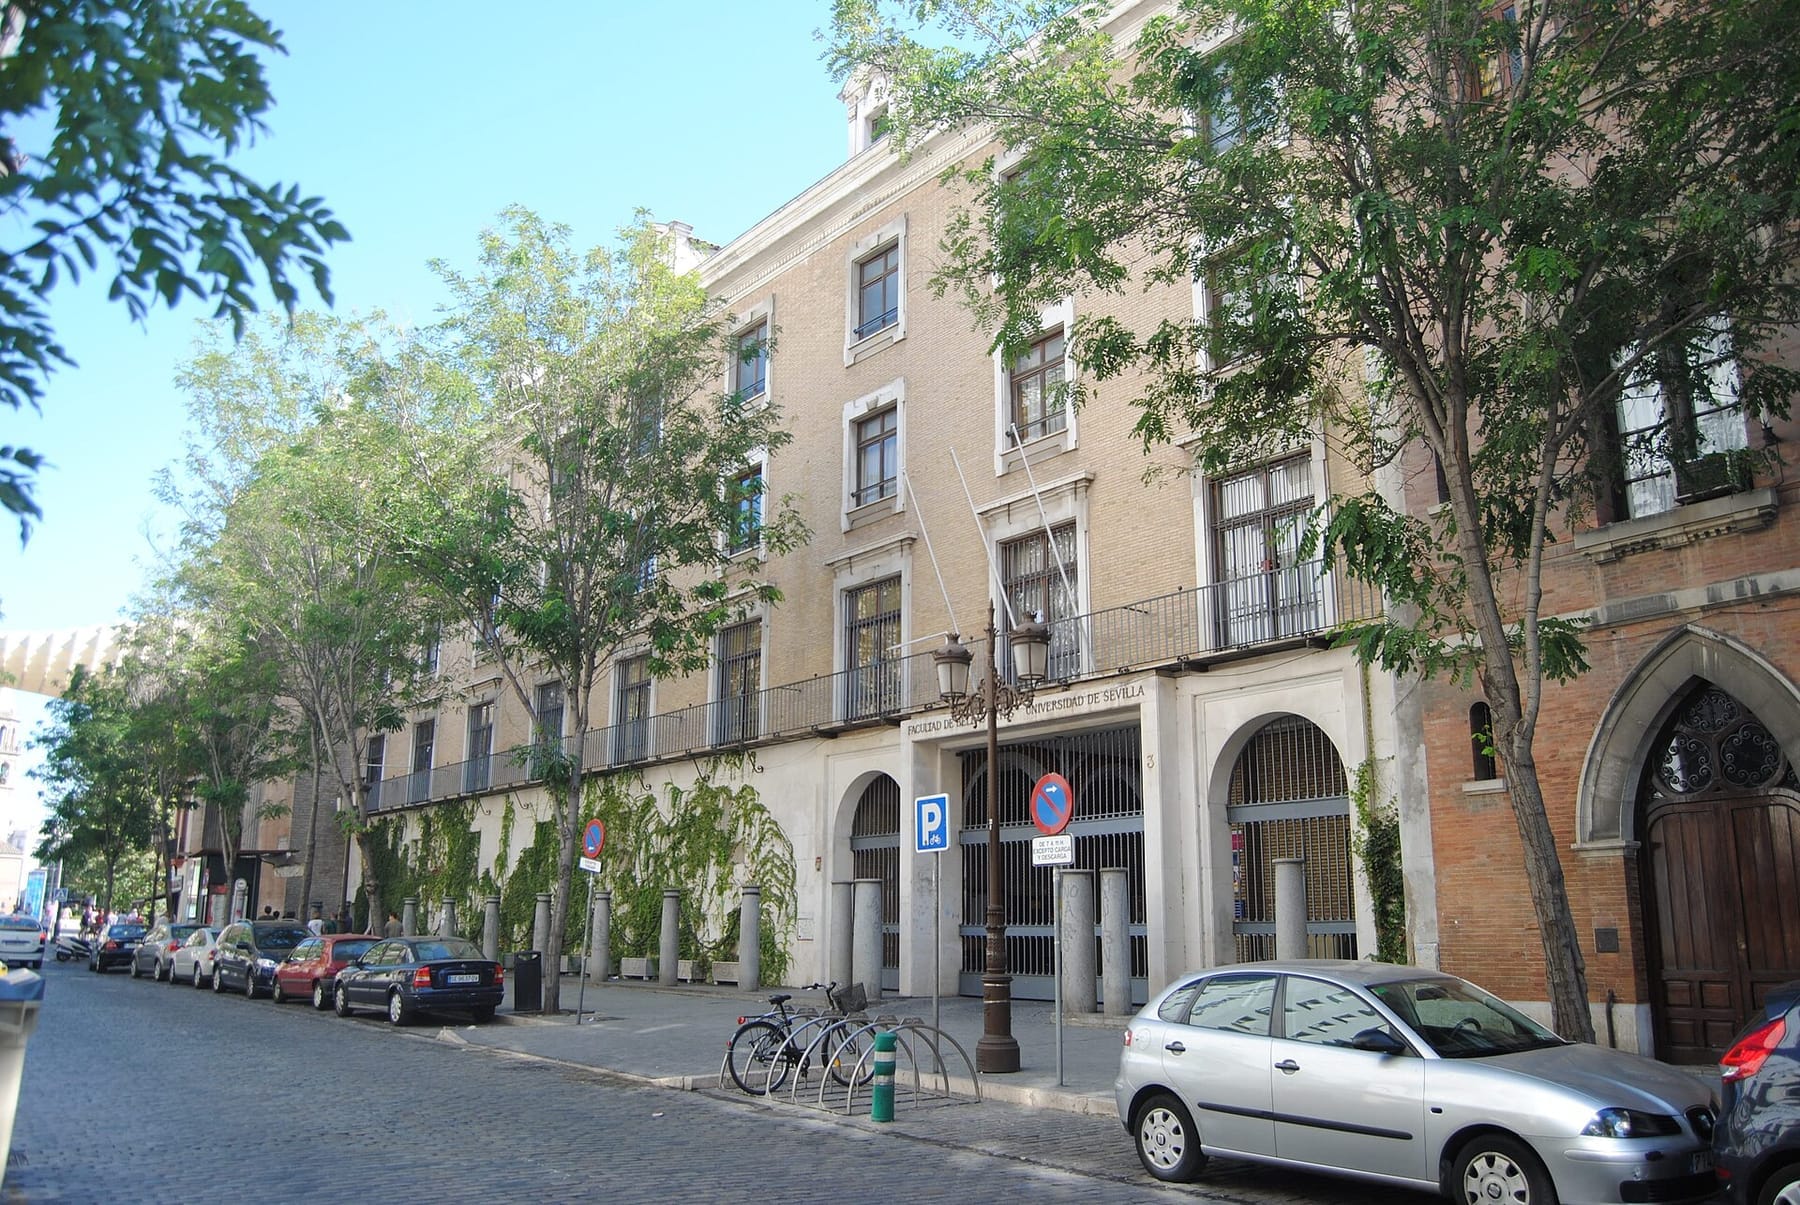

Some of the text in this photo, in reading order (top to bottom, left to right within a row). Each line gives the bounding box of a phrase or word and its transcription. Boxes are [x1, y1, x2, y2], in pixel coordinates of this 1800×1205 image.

[1025, 694, 1084, 716] UNIVERSIDAD
[1087, 692, 1101, 704] DE
[1103, 684, 1145, 702] SEVILLA
[907, 720, 942, 736] FACULTAD
[944, 718, 954, 730] DE
[1146, 753, 1155, 769] 3
[921, 802, 942, 847] P
[1054, 845, 1071, 853] CARGA
